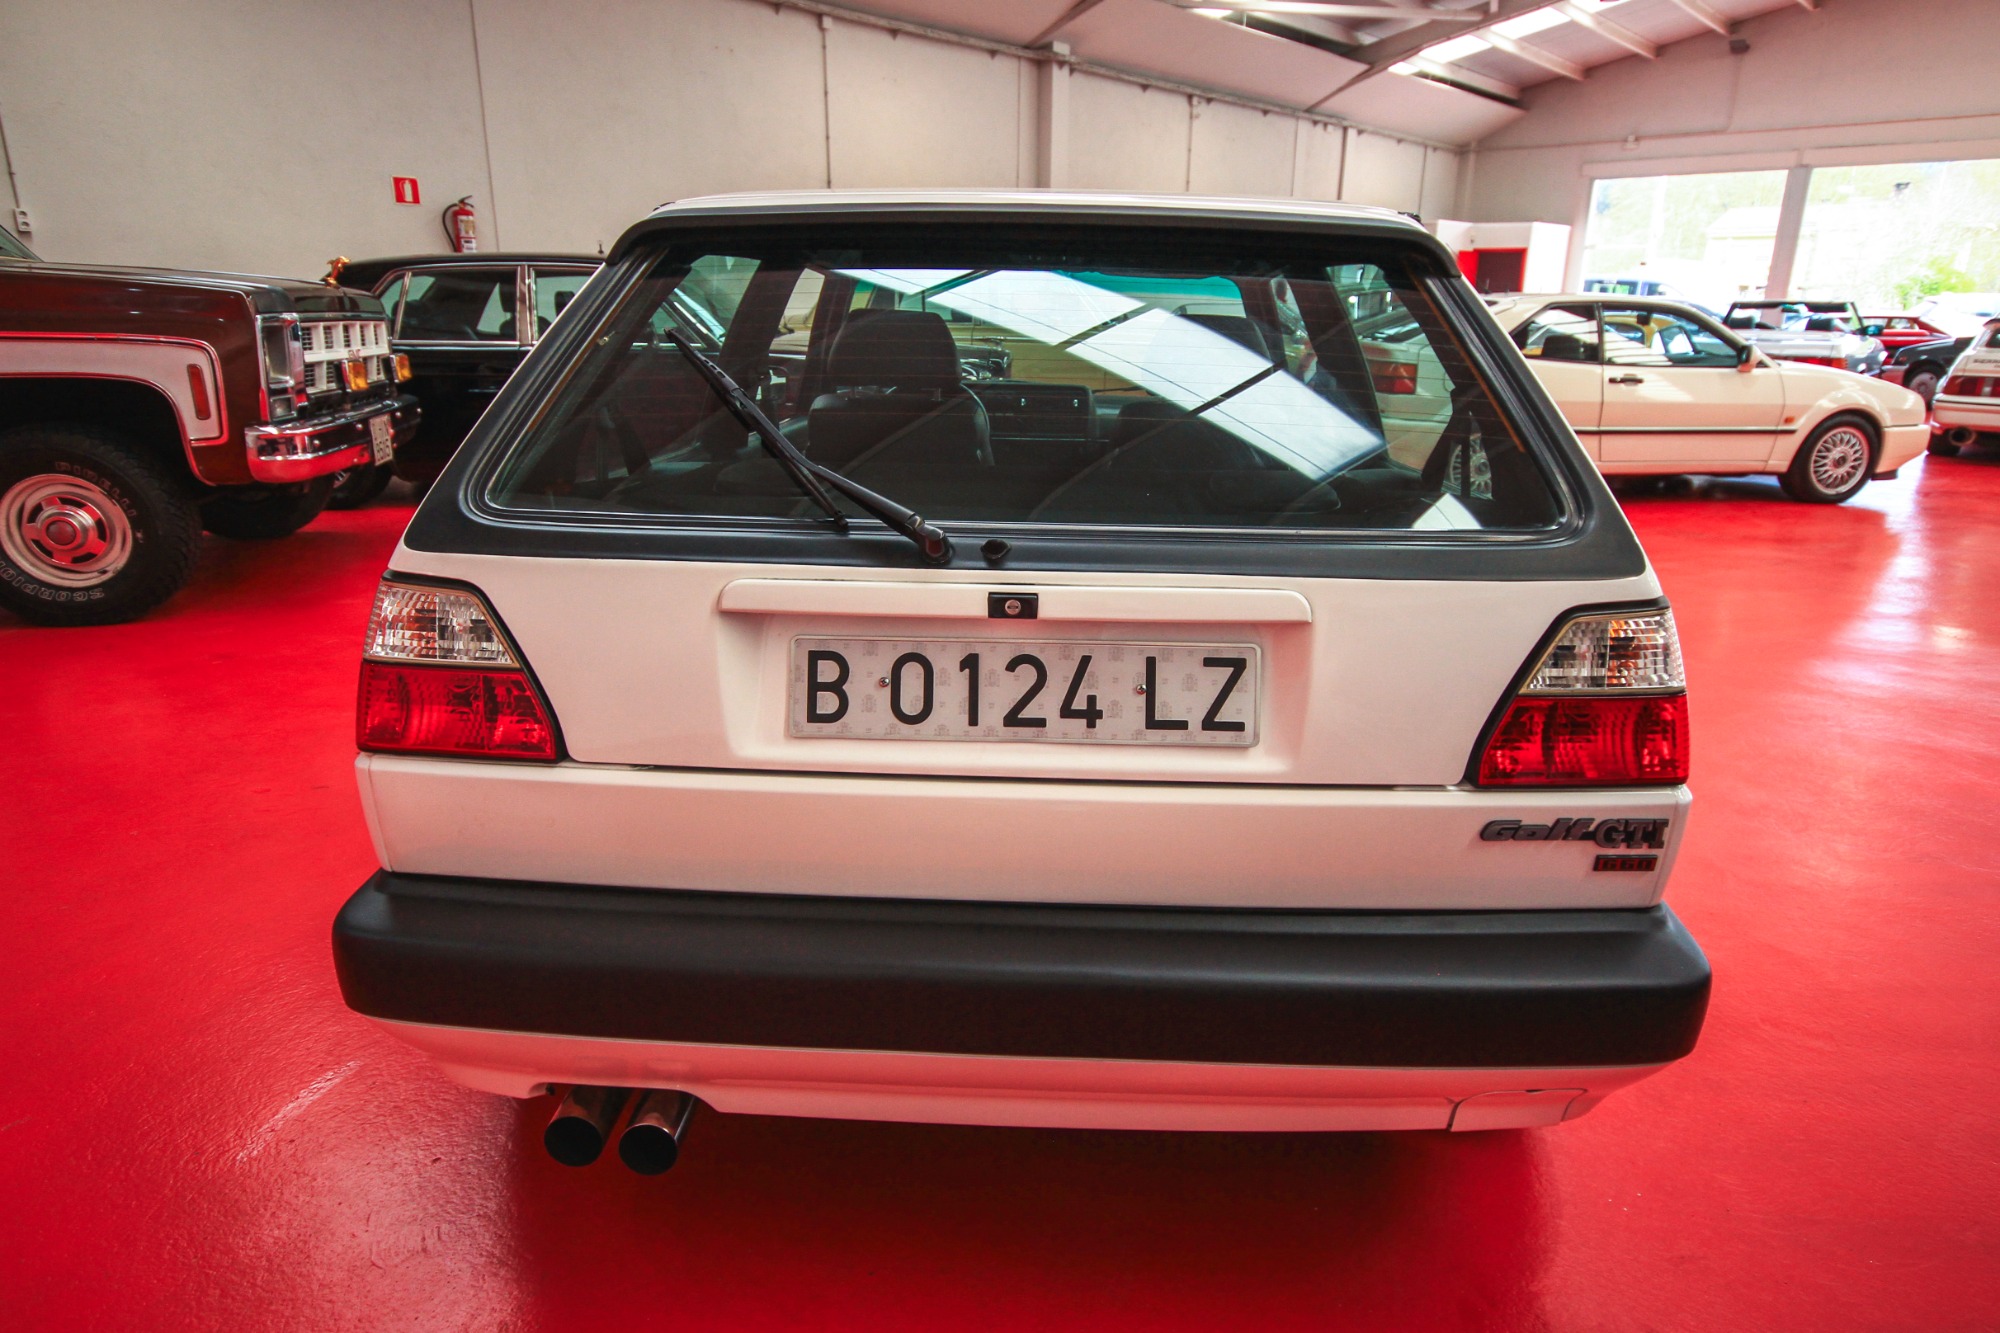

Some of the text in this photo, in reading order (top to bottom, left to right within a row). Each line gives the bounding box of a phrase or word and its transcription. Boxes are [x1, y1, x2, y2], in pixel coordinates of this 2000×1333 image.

[806, 650, 1248, 732] B 0124 LZ
[1480, 817, 1670, 849] Golf GTI
